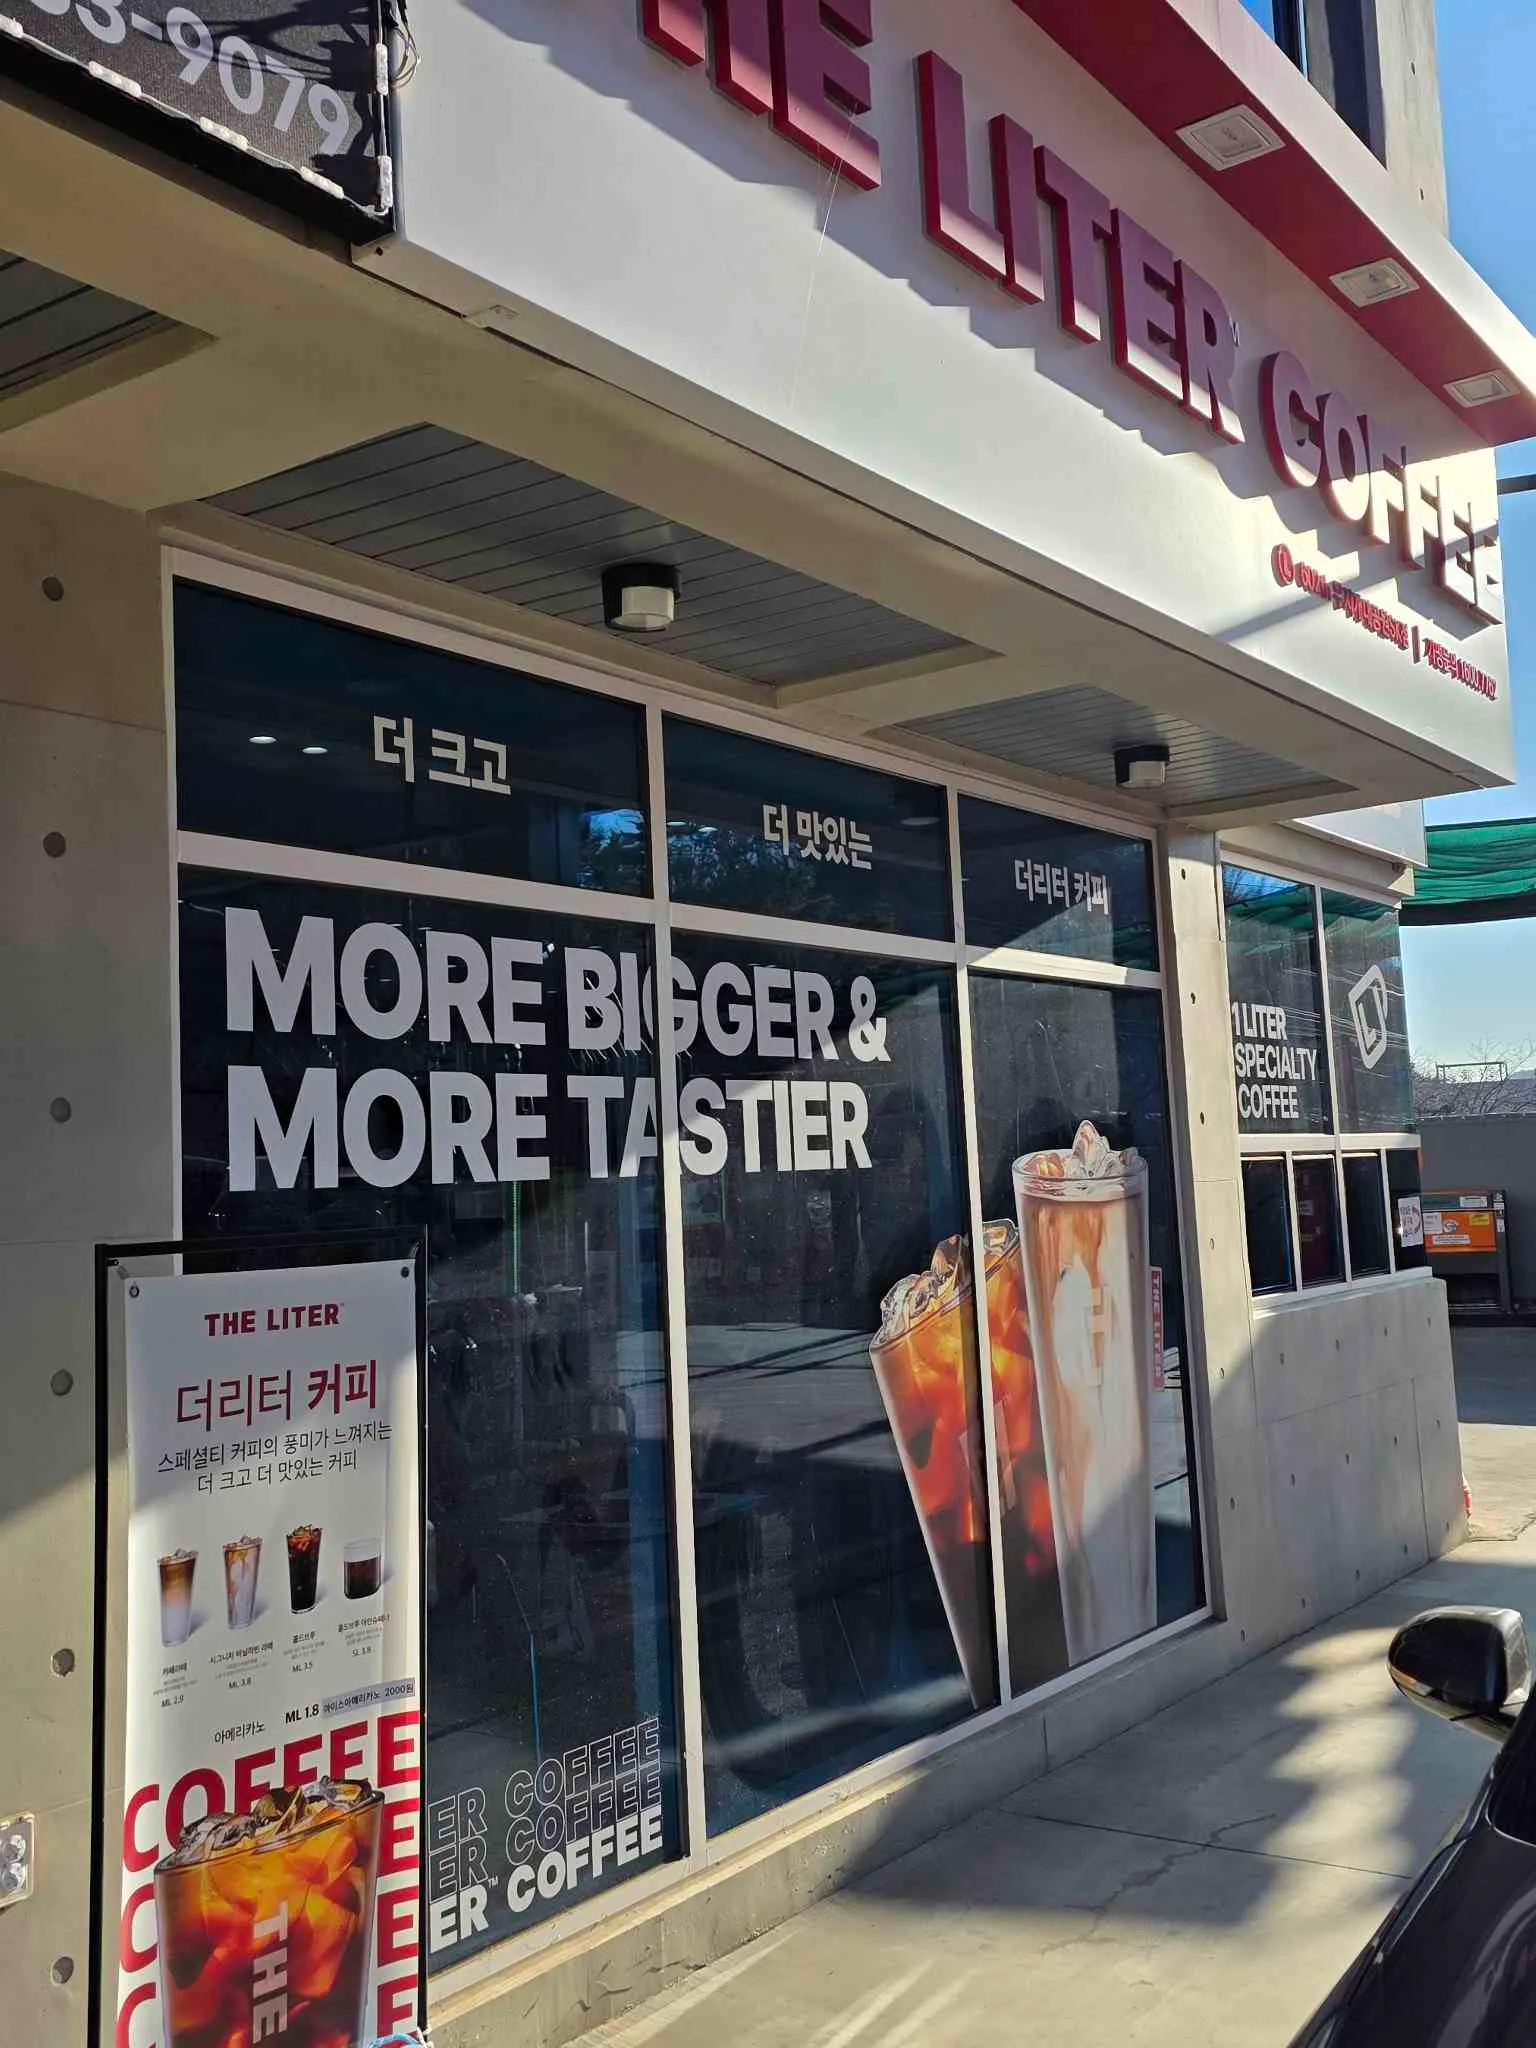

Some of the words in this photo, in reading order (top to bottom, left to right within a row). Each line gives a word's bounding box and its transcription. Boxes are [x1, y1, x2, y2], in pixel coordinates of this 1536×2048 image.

[31, 0, 350, 156] 3-9079
[915, 50, 1245, 444] LITER
[373, 715, 415, 783] 더
[428, 728, 512, 795] 크고
[763, 804, 789, 856] 더
[796, 810, 872, 870] 맛있는
[1014, 859, 1070, 908] 더리터
[1073, 871, 1109, 915] 커피
[225, 906, 546, 1046] MORE
[564, 946, 839, 1061] BIGGER
[848, 975, 891, 1063] &
[1234, 1042, 1317, 1081] SPECIALTY
[227, 1065, 550, 1192] MORE
[567, 1074, 872, 1179] TASTIER
[1238, 1083, 1299, 1119] COFFEE
[204, 1309, 257, 1337] THE
[266, 1302, 340, 1332] LITER
[176, 1369, 292, 1432] 더리터
[307, 1359, 377, 1415] 커피
[157, 1443, 225, 1473] 스페셜티
[231, 1435, 279, 1463] 커피의
[282, 1428, 330, 1455] 풍미가
[333, 1419, 394, 1445] 느껴지는
[197, 1473, 214, 1495] 더
[219, 1468, 253, 1491] 크고
[257, 1463, 273, 1486] 더
[278, 1456, 324, 1483] 맛있는
[328, 1448, 358, 1474] 커피
[213, 1720, 267, 1745] 아메리카노
[284, 1708, 303, 1724] ML
[304, 1703, 320, 1719] 1.8
[505, 1717, 661, 1818] COFFEE
[506, 1761, 662, 1866] COFFEE
[507, 1804, 663, 1913] COFFEE
[252, 1901, 288, 2046] THE
